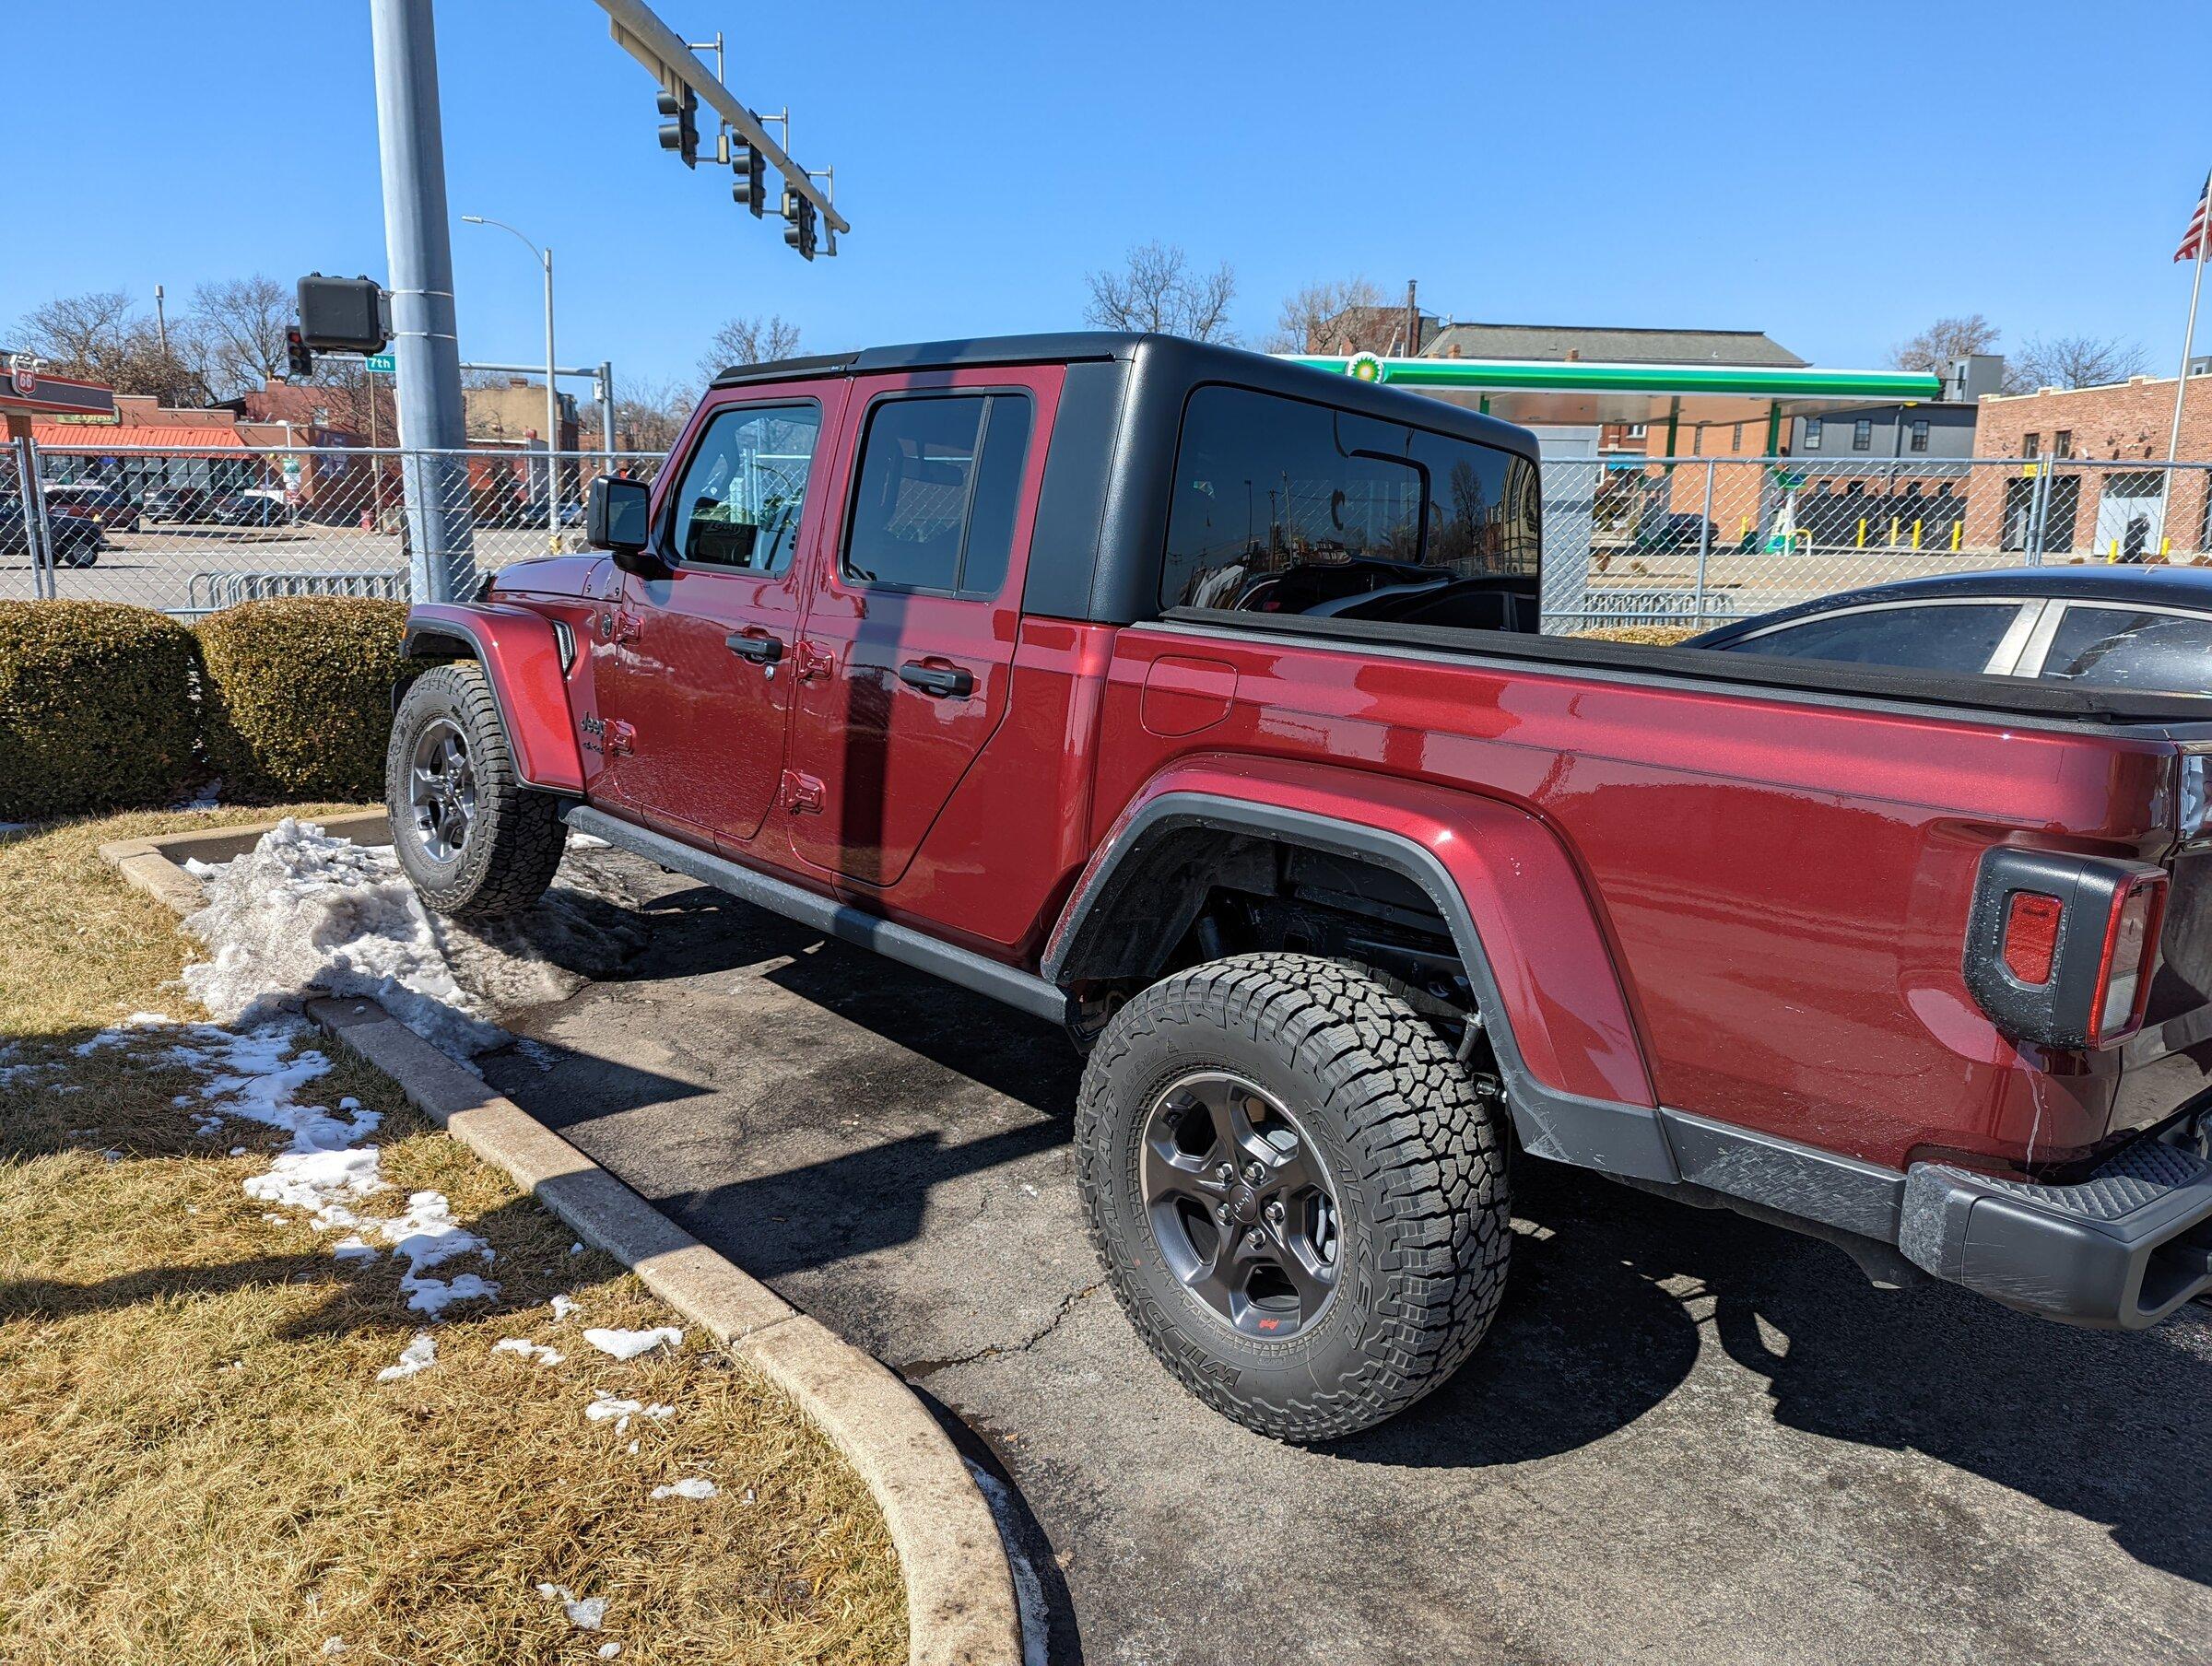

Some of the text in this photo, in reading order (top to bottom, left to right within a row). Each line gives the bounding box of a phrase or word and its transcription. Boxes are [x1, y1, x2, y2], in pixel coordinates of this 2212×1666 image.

[369, 358, 391, 369] 7th
[19, 372, 33, 388] 66
[75, 414, 112, 423] Express
[581, 710, 606, 741] Jeep
[1304, 1099, 1375, 1350] FALKEN
[1096, 1168, 1242, 1388] WILDPEAK
